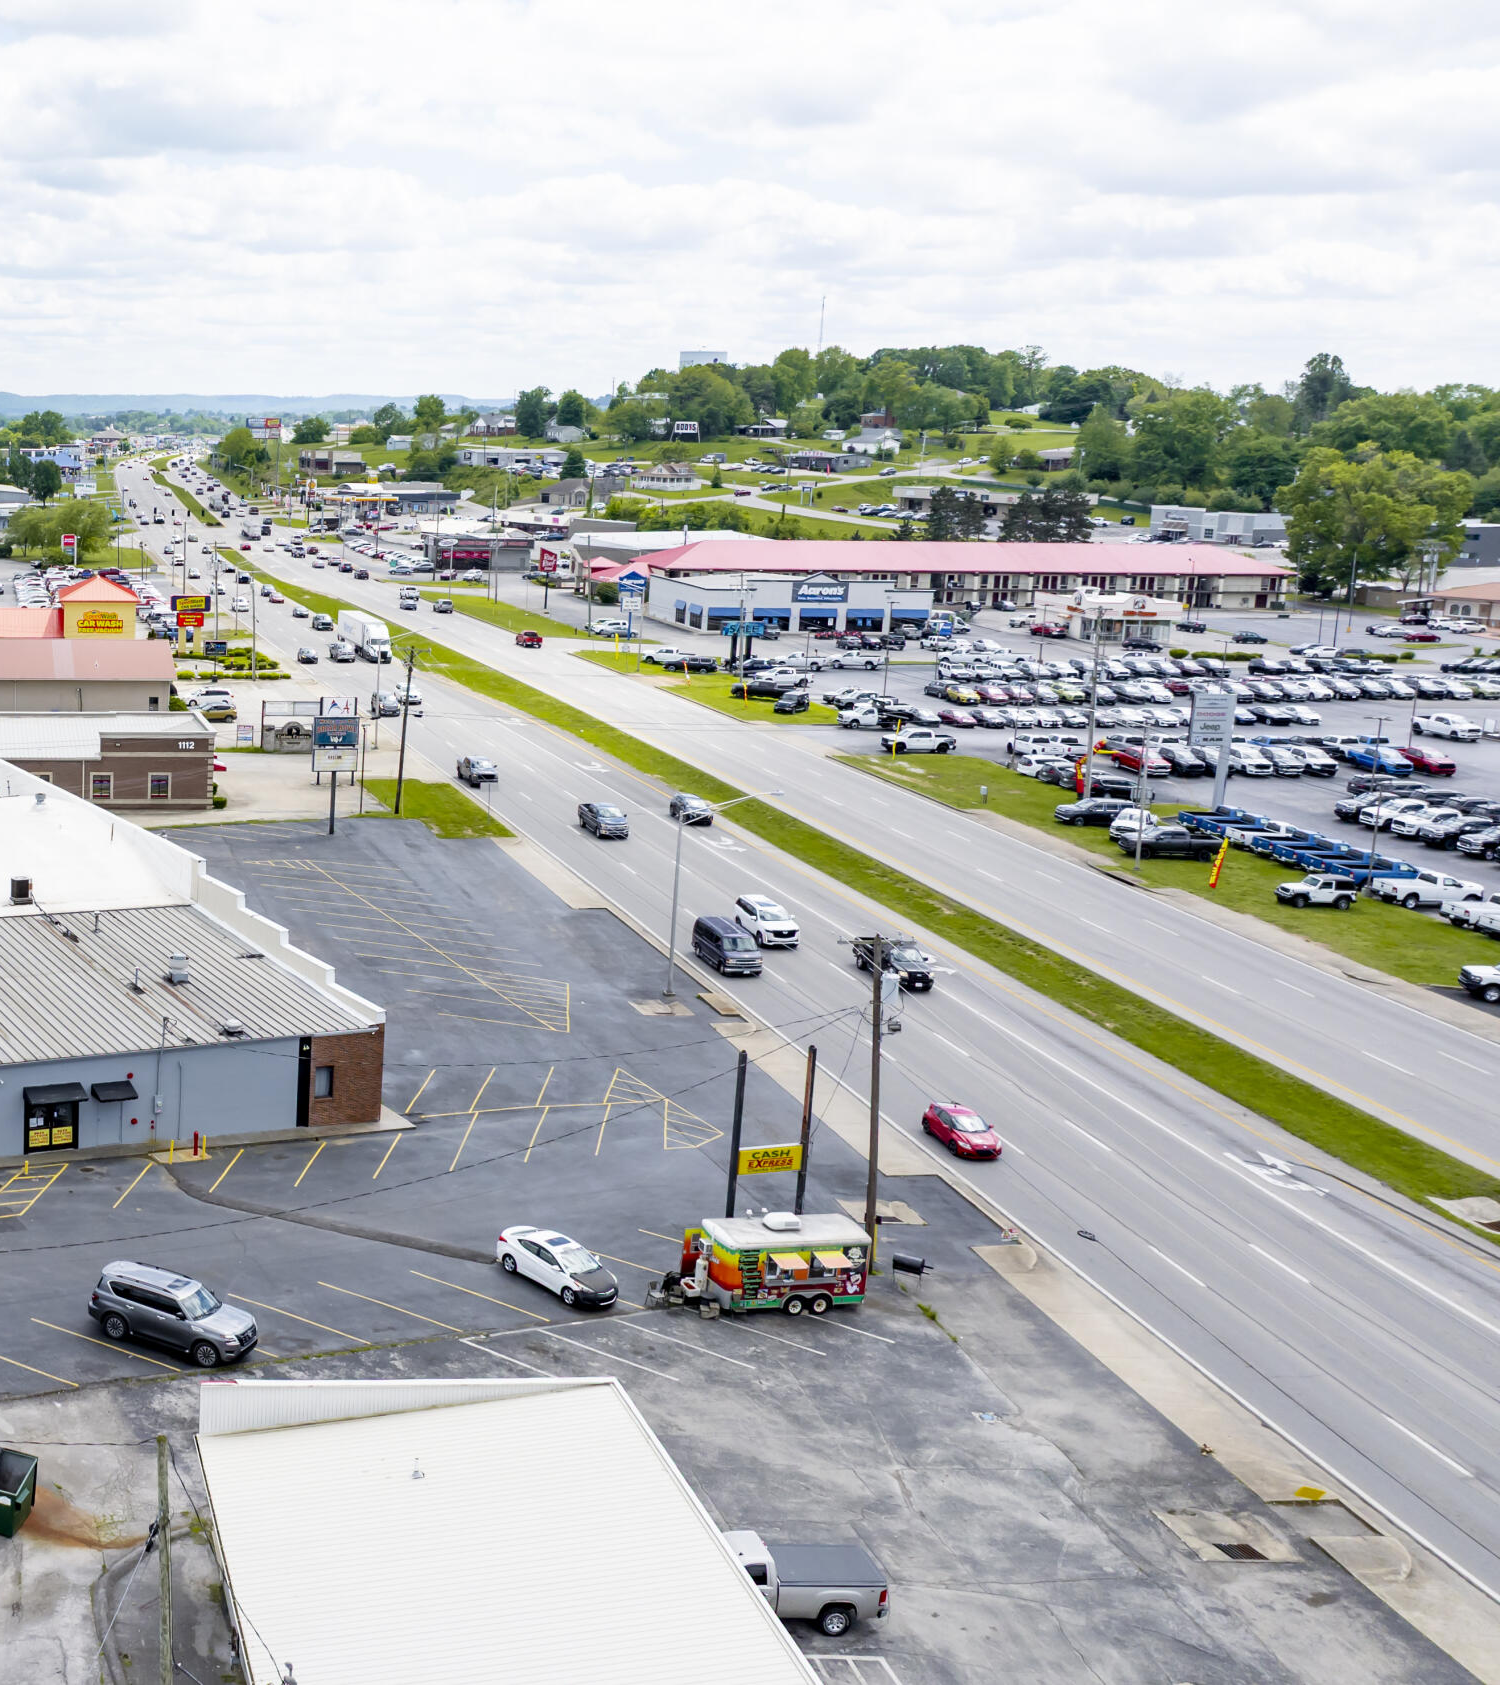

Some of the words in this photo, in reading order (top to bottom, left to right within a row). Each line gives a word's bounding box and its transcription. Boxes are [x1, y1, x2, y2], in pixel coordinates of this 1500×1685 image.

[797, 584, 845, 596] Aaron's
[1199, 722, 1221, 731] Jeep
[178, 741, 195, 749] 1112
[751, 1149, 791, 1160] CASH
[747, 1157, 795, 1169] EXPRESS
